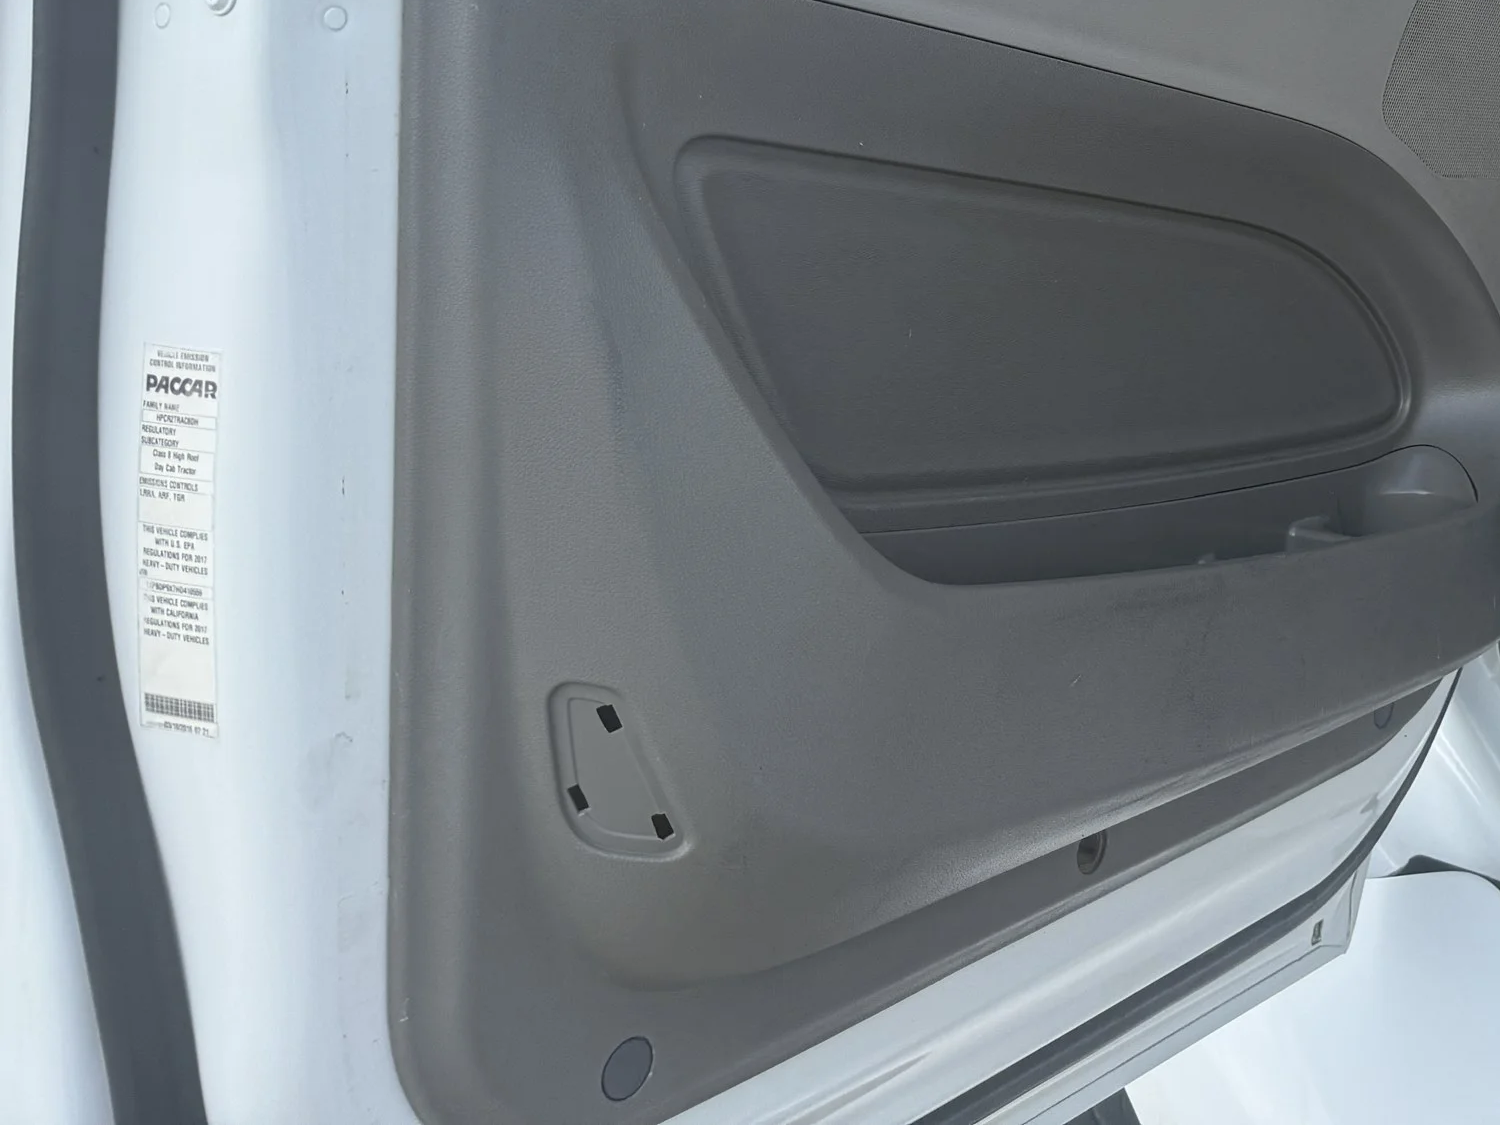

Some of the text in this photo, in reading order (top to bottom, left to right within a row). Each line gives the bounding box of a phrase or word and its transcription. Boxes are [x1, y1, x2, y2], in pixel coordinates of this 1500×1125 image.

[180, 352, 209, 362] EMISSION
[149, 359, 216, 372] CONTROL INFORMATION
[146, 374, 217, 399] PACCAR
[143, 400, 180, 412] FAMILY NAME
[141, 424, 176, 435] REGULATORY
[141, 436, 179, 447] SUBCATEGORY
[153, 448, 167, 458] Class
[173, 451, 185, 462] High
[187, 454, 199, 462] Roof
[154, 462, 196, 475] Day Cab Tractor
[140, 476, 198, 491] EMISSIONS CONTROLS
[143, 524, 208, 541] THIS VEHICLE COMPLIES
[155, 537, 170, 546] WITH
[183, 541, 195, 550] EPA
[143, 547, 208, 564] REGULATIONS FOR 2017
[142, 559, 160, 568] HEAVY
[165, 562, 180, 572] DUTY
[181, 565, 208, 575] VEHICLES
[156, 595, 178, 606] VEHICLE
[180, 600, 208, 611] COMPLIES
[150, 606, 199, 620] WITH CALIFORNIA
[143, 617, 179, 629] REGULATIONS
[181, 622, 193, 632] FOR
[143, 628, 161, 638] HEAVY
[166, 631, 182, 641] DUTY
[182, 634, 210, 645] VEHICLES
